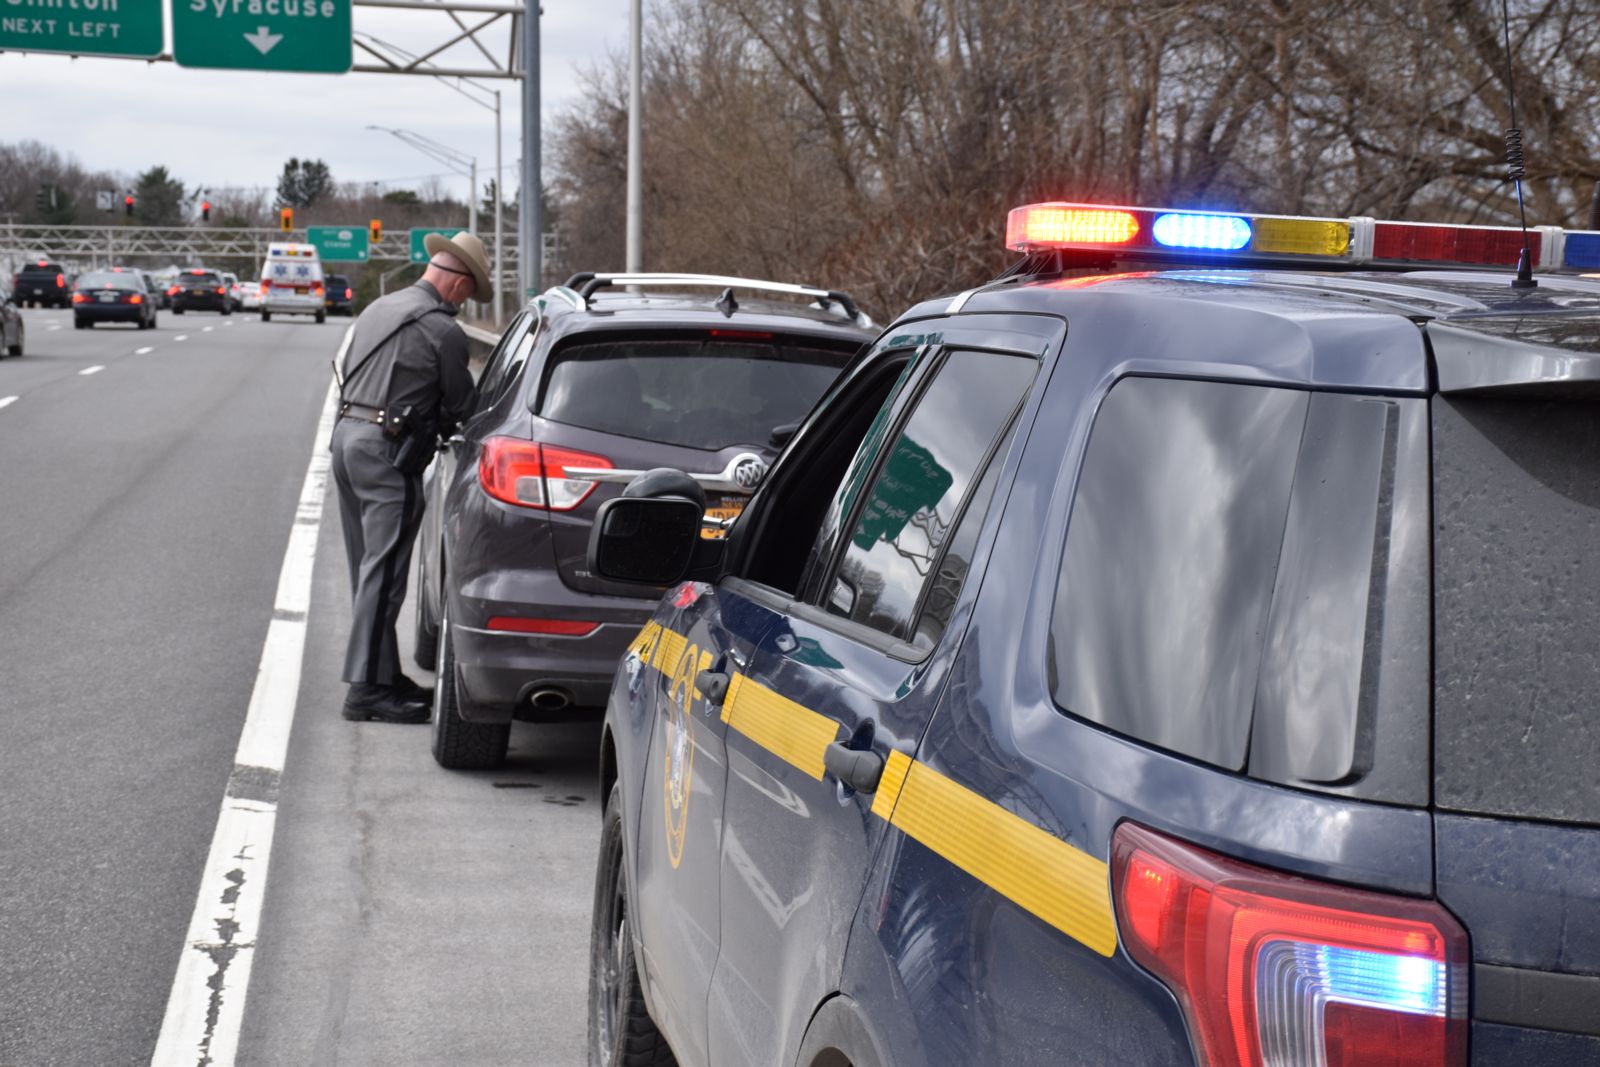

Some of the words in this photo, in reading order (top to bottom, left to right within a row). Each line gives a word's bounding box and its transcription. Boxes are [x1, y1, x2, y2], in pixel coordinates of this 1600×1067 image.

[190, 0, 335, 18] Syracuse
[2, 17, 57, 35] NEXT
[68, 21, 121, 38] LEFT
